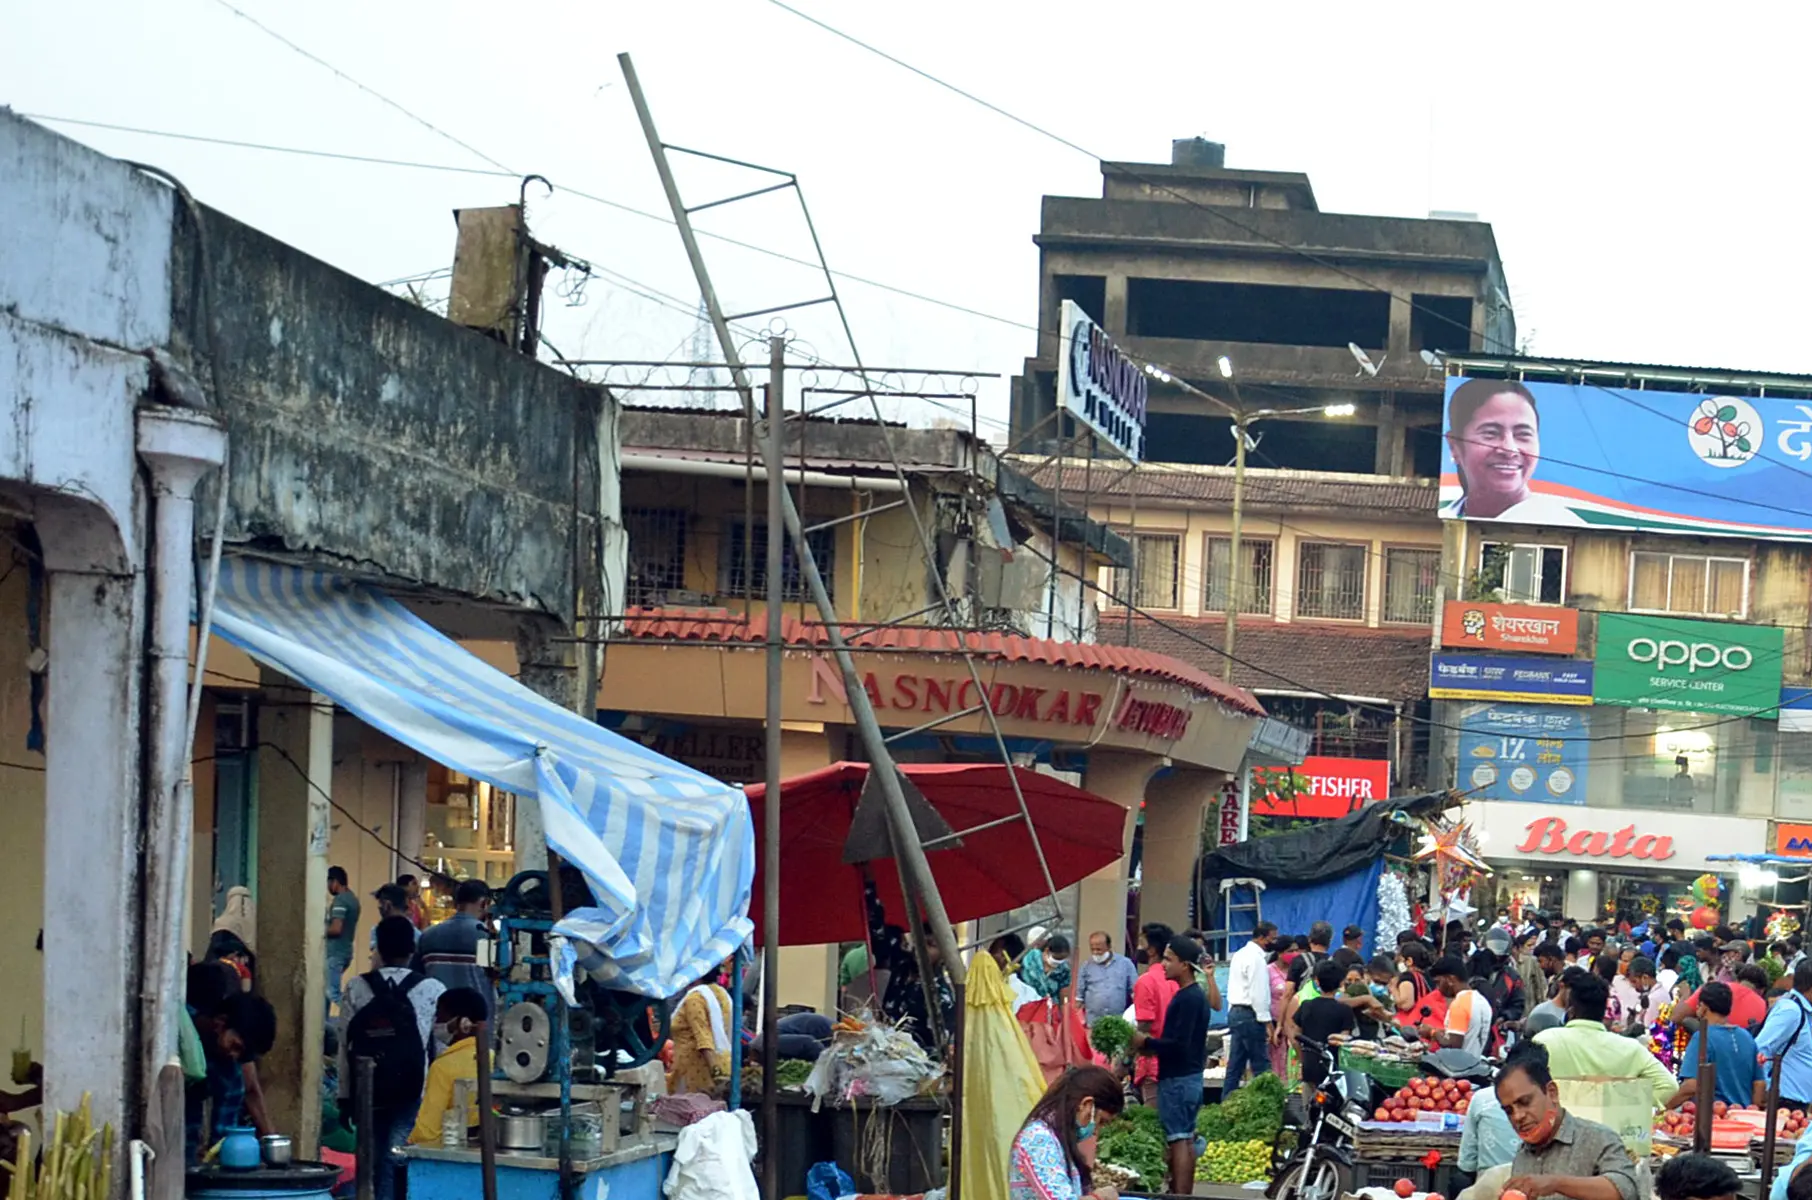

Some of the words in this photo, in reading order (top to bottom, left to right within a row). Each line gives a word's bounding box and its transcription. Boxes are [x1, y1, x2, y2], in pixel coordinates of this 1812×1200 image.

[1491, 612, 1560, 636] शेयरखान
[1627, 638, 1753, 673] oppo
[810, 654, 1102, 727] NASNODKAR
[1649, 675, 1688, 691] SERVICE
[1517, 816, 1676, 861] Bata
